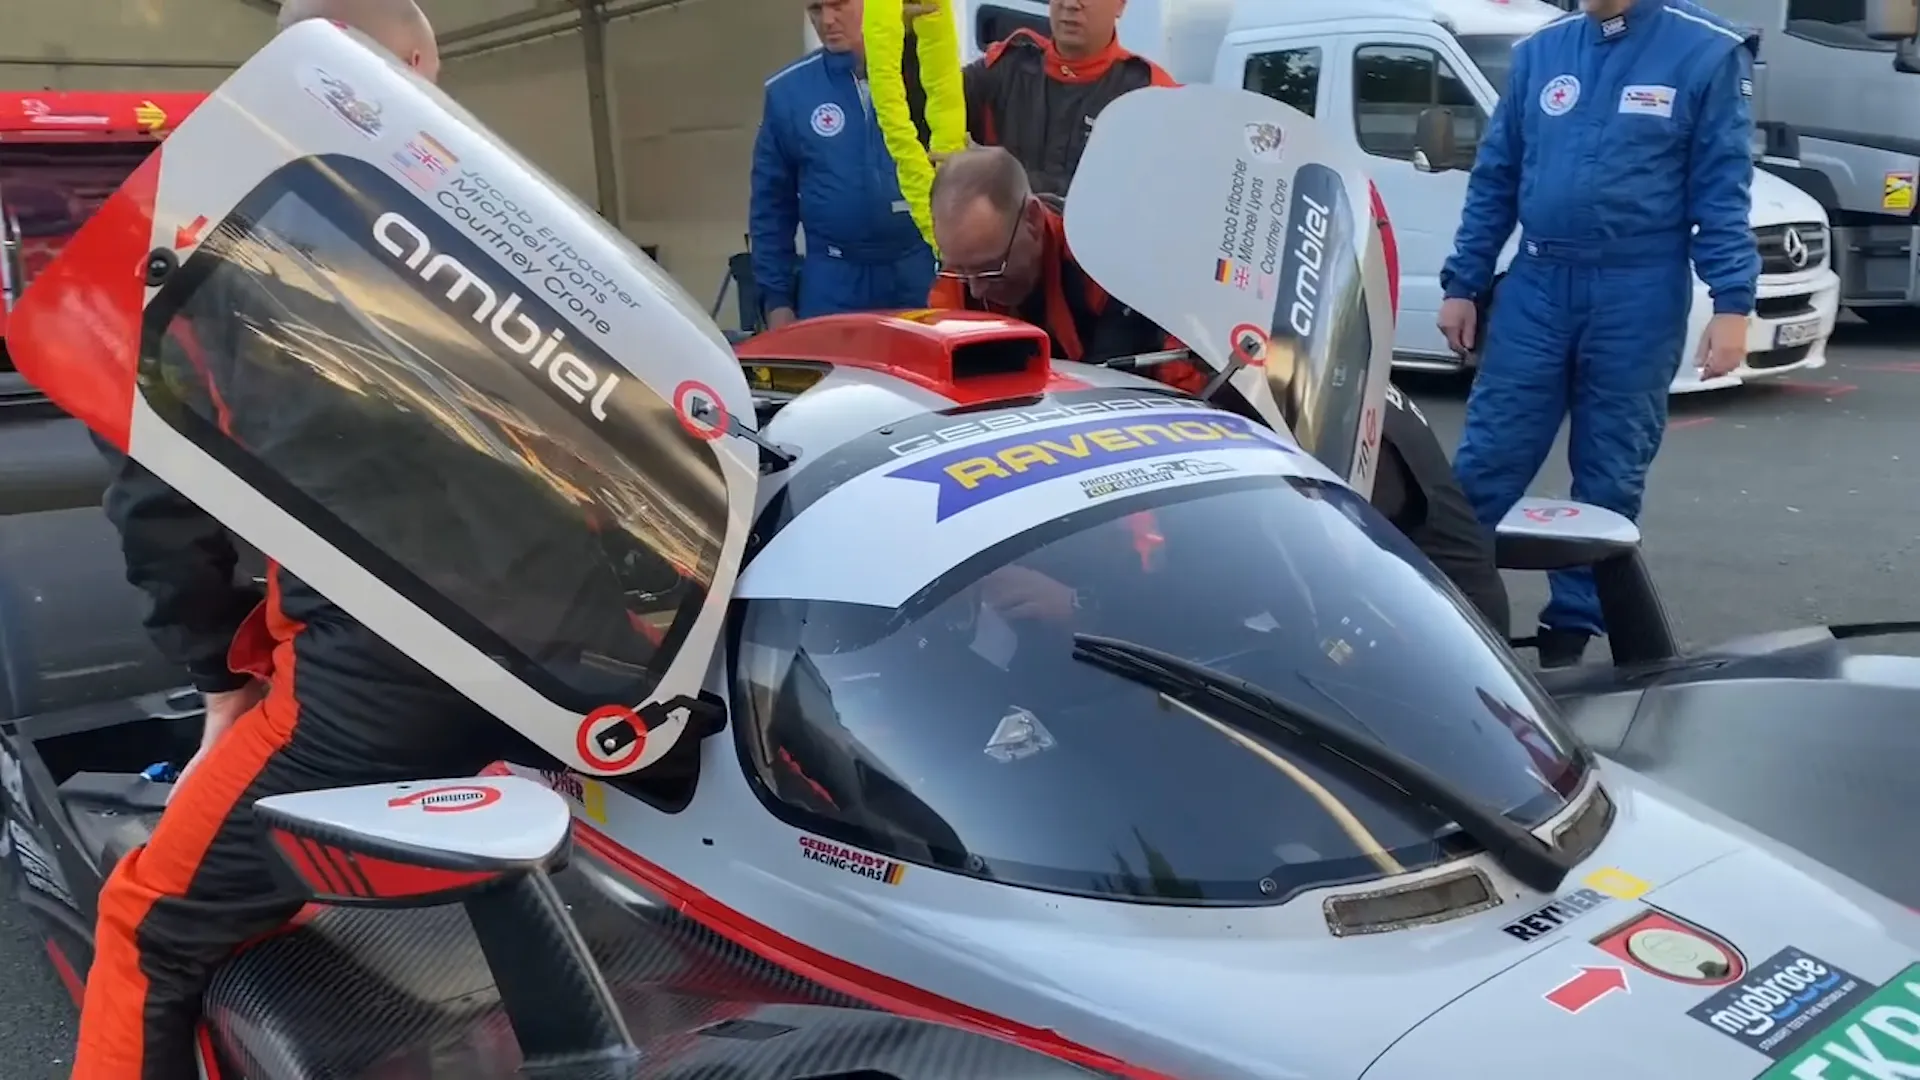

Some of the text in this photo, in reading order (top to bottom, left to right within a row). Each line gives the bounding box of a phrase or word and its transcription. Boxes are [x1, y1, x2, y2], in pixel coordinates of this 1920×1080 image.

[450, 178, 608, 305] Michael Lyons
[461, 169, 642, 309] Jacob Erlbacher
[1220, 217, 1238, 257] Jacob
[1238, 177, 1264, 264] Michael Lyons
[1260, 179, 1288, 275] Courtney Crone
[436, 190, 612, 335] Courtney Crone
[1290, 194, 1330, 336] ambiel
[373, 212, 620, 422] ambiel
[943, 420, 1257, 490] RAVENOL
[1079, 467, 1147, 488] PROTOTYPE
[798, 836, 886, 868] GEBHARDT
[803, 848, 882, 881] RACING-CARS
[1502, 888, 1611, 942] REYHER
[1710, 957, 1828, 1036] myobrace
